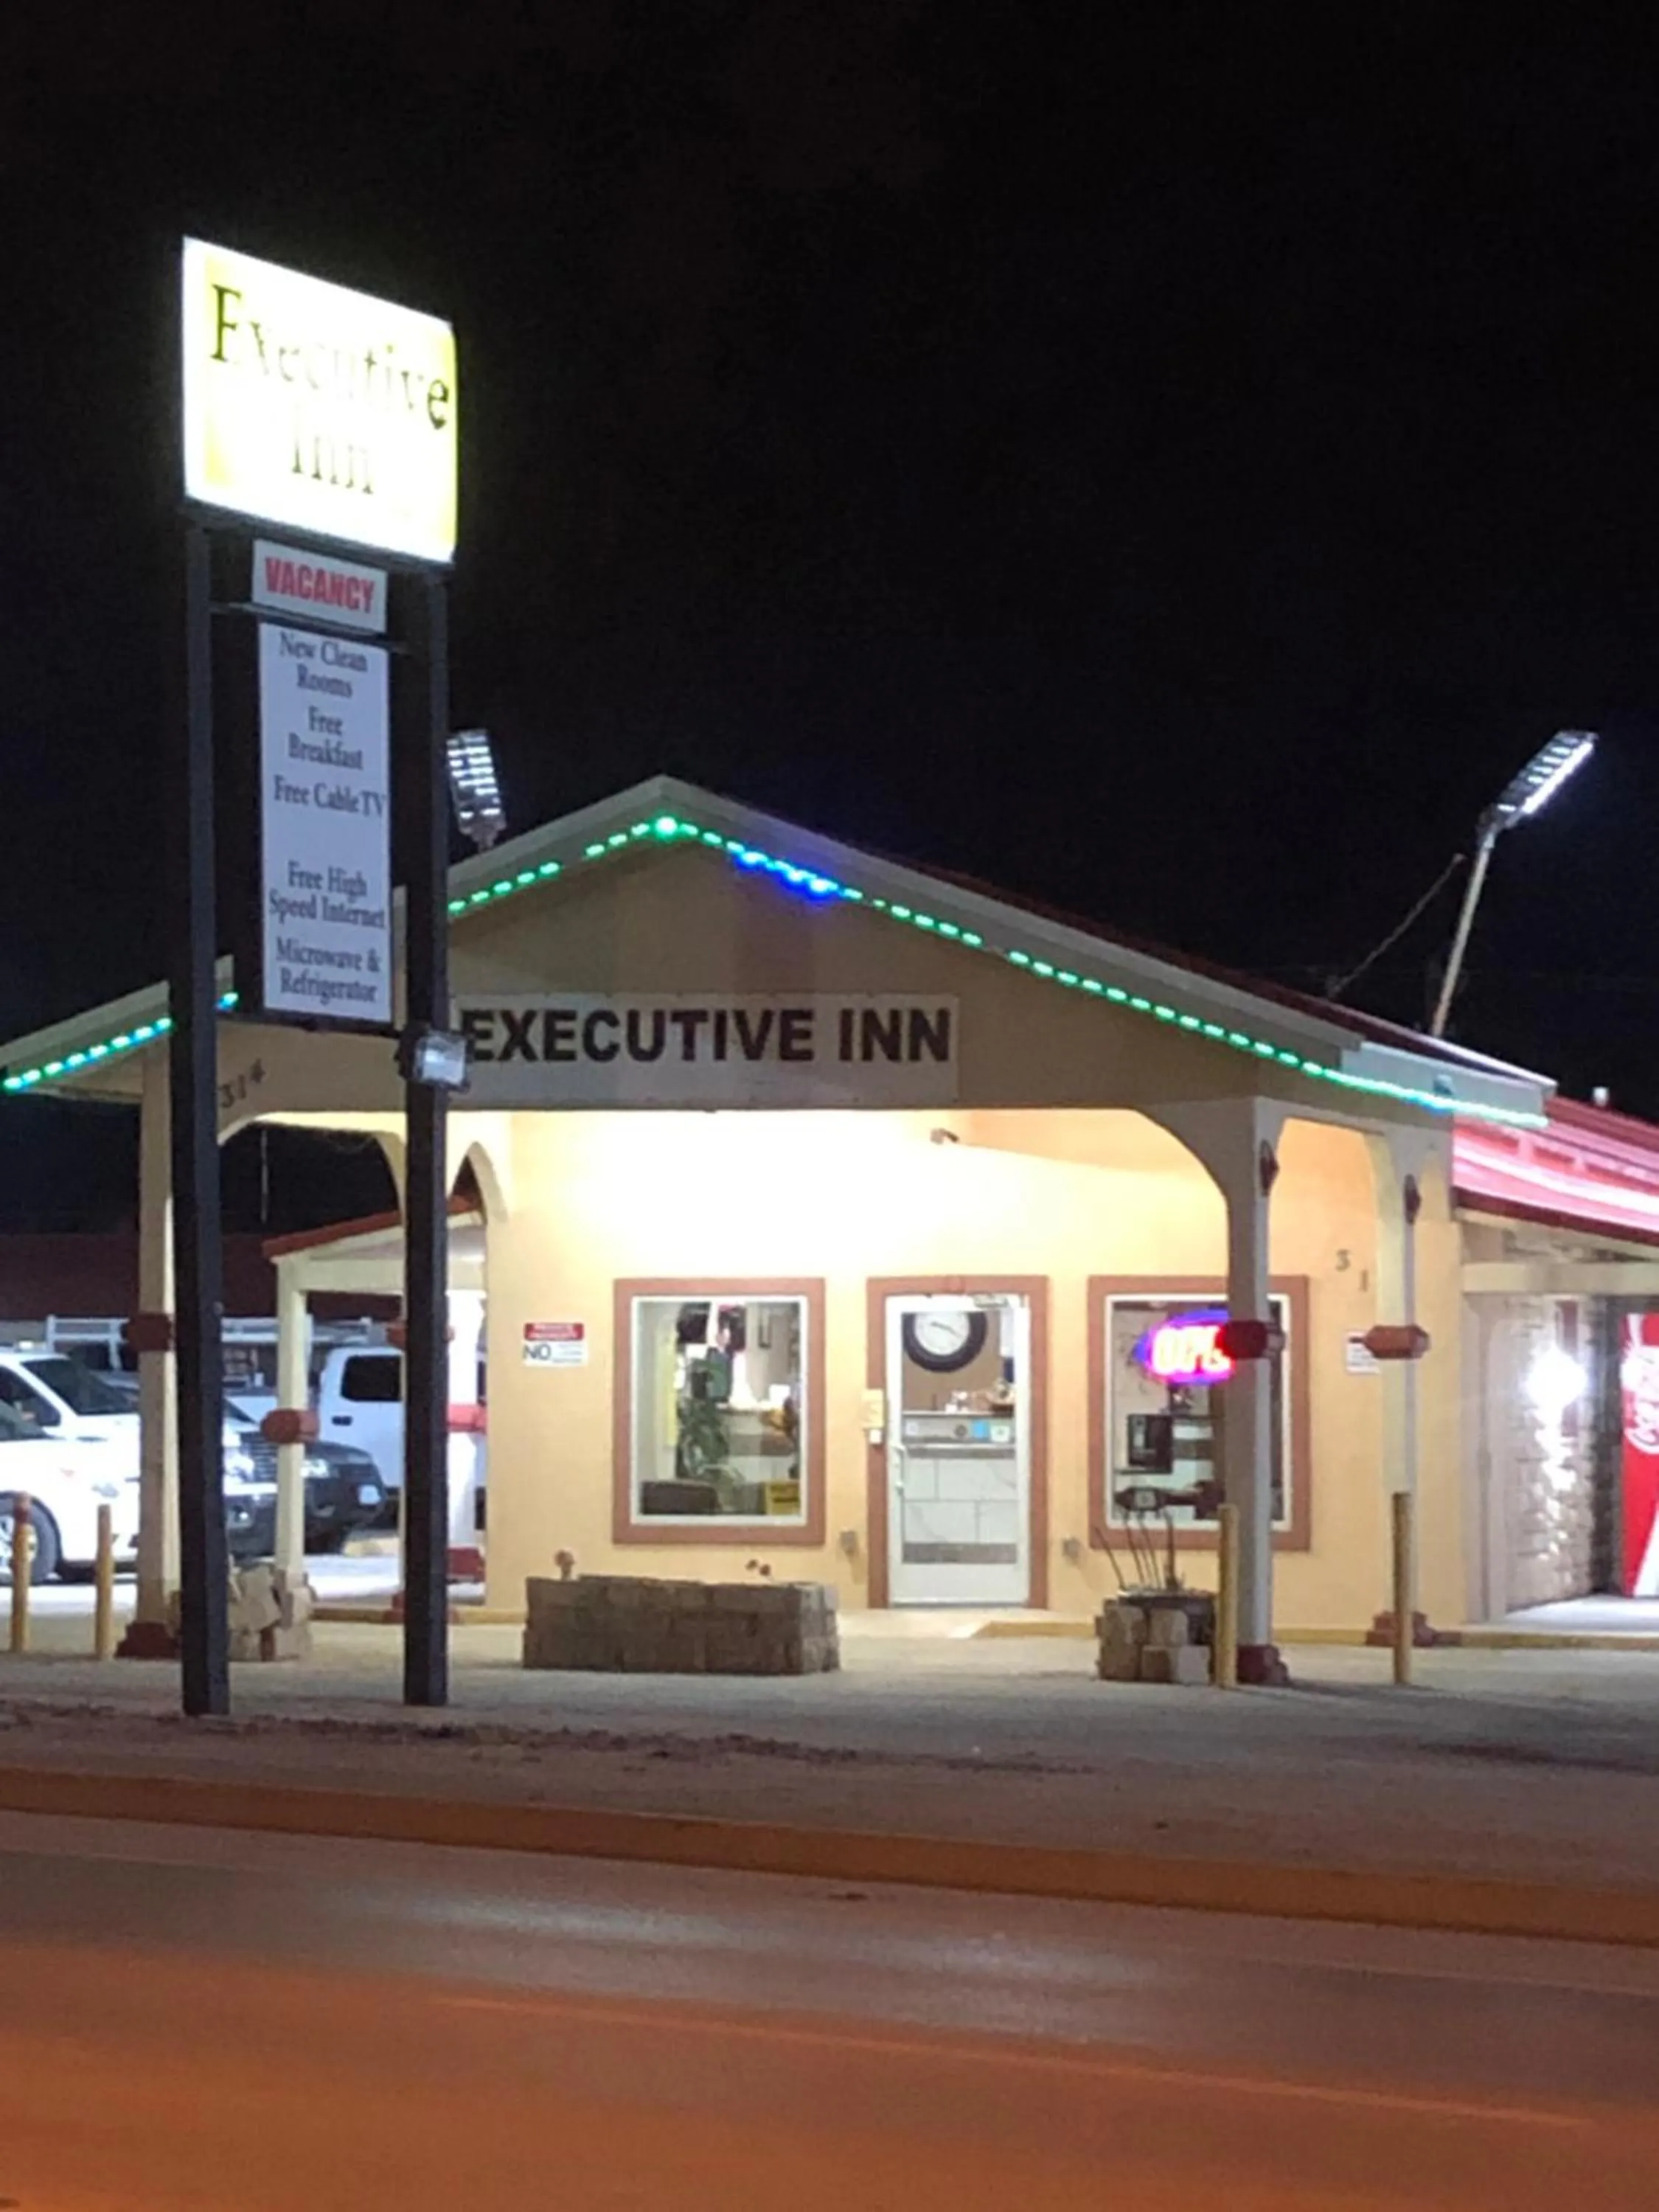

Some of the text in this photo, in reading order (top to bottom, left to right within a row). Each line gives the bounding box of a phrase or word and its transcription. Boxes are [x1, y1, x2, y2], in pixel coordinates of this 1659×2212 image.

[265, 556, 375, 613] VACANCY
[279, 631, 368, 672] New Clean
[296, 664, 352, 698] Rooms
[307, 705, 344, 737] Free
[288, 732, 364, 771] Breakfast
[273, 773, 386, 818] Free Cable TV
[288, 860, 367, 903] Free High
[269, 888, 385, 929] Speed Internet
[275, 936, 380, 973] Microwave &
[279, 966, 378, 1005] Refrigerator
[459, 1007, 951, 1062] EXECUTIVE INN
